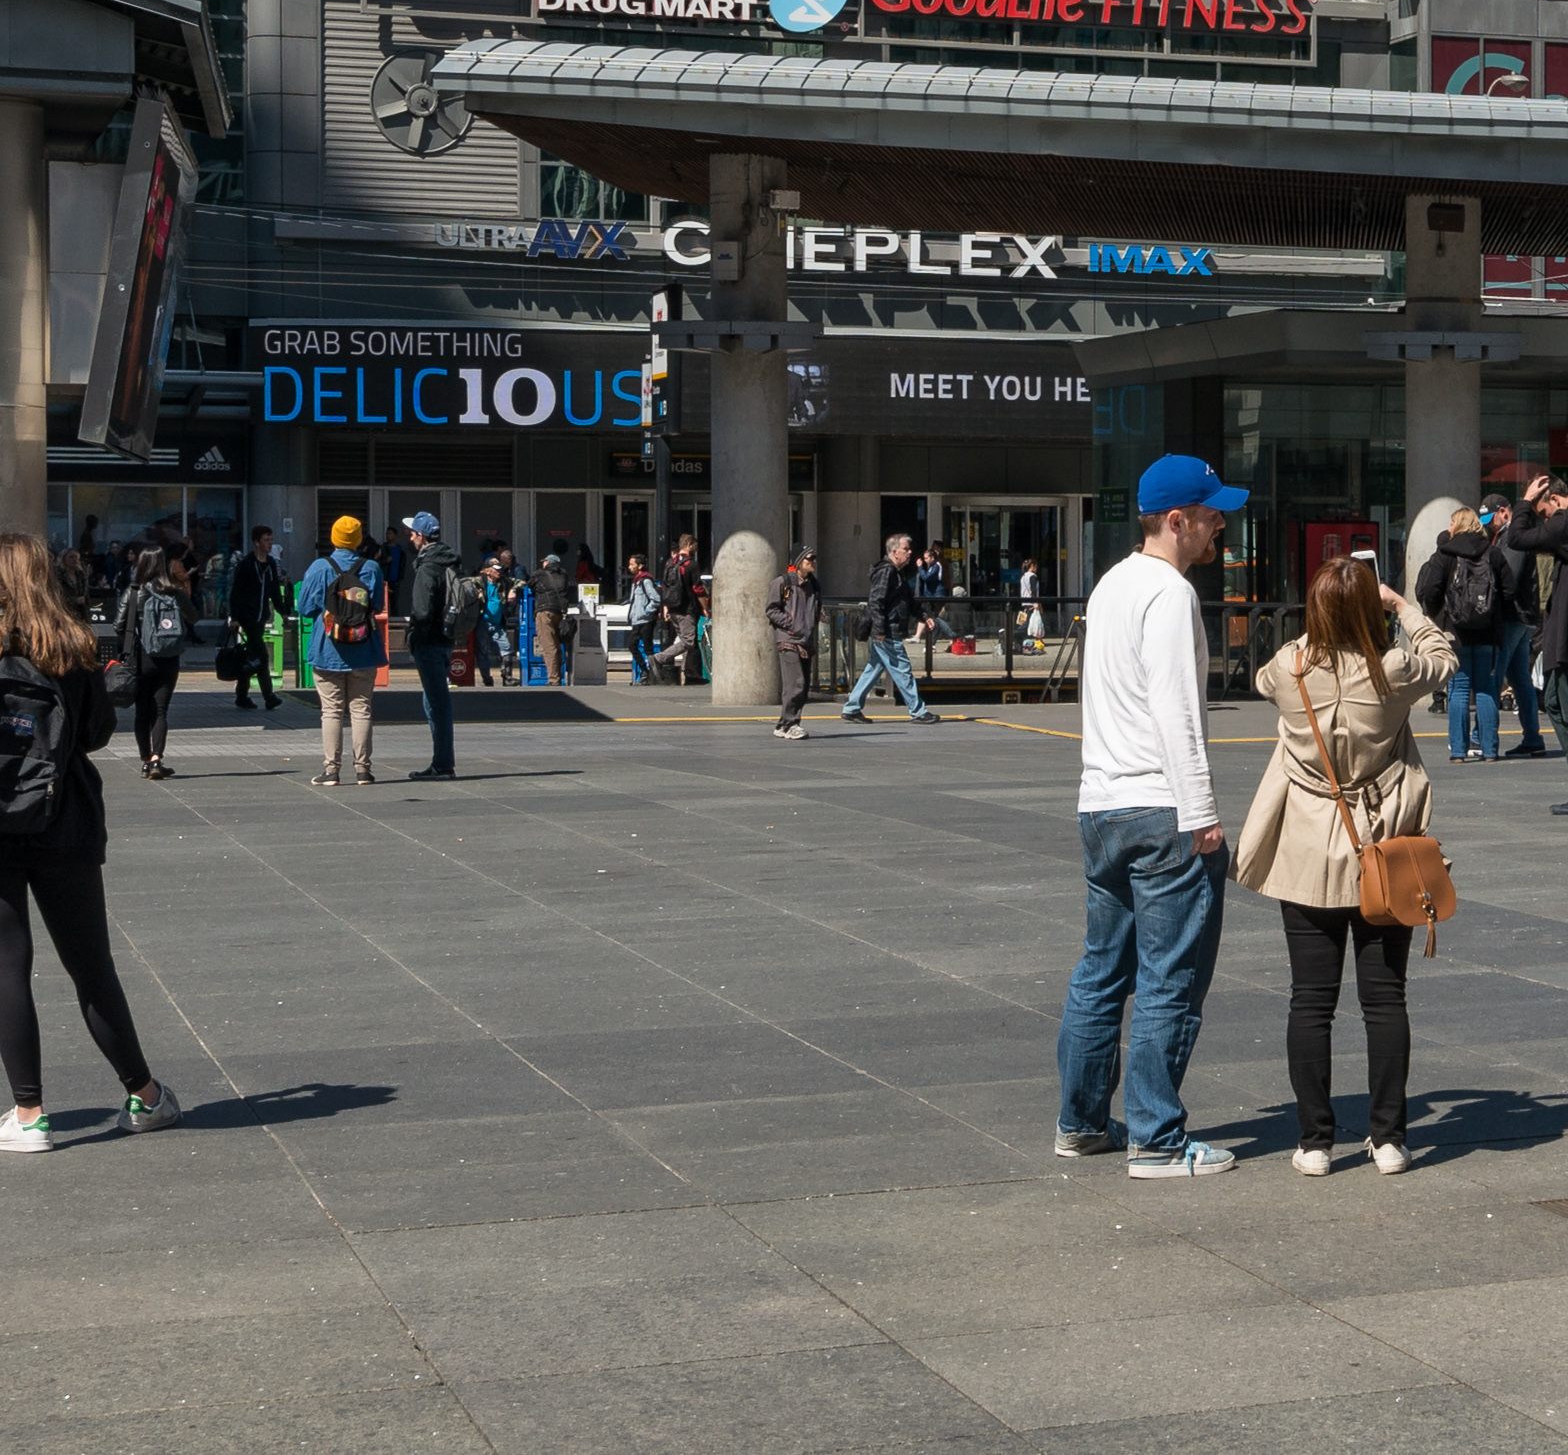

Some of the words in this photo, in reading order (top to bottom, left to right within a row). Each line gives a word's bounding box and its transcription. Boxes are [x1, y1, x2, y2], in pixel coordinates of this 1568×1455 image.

[663, 219, 1058, 279] CEPLEX
[1088, 244, 1215, 276] IMAX
[264, 330, 340, 355] GRAB
[350, 331, 522, 357] SOMETHING
[890, 373, 973, 399] MEET
[984, 375, 1042, 402] YOU
[194, 462, 231, 472] adidas
